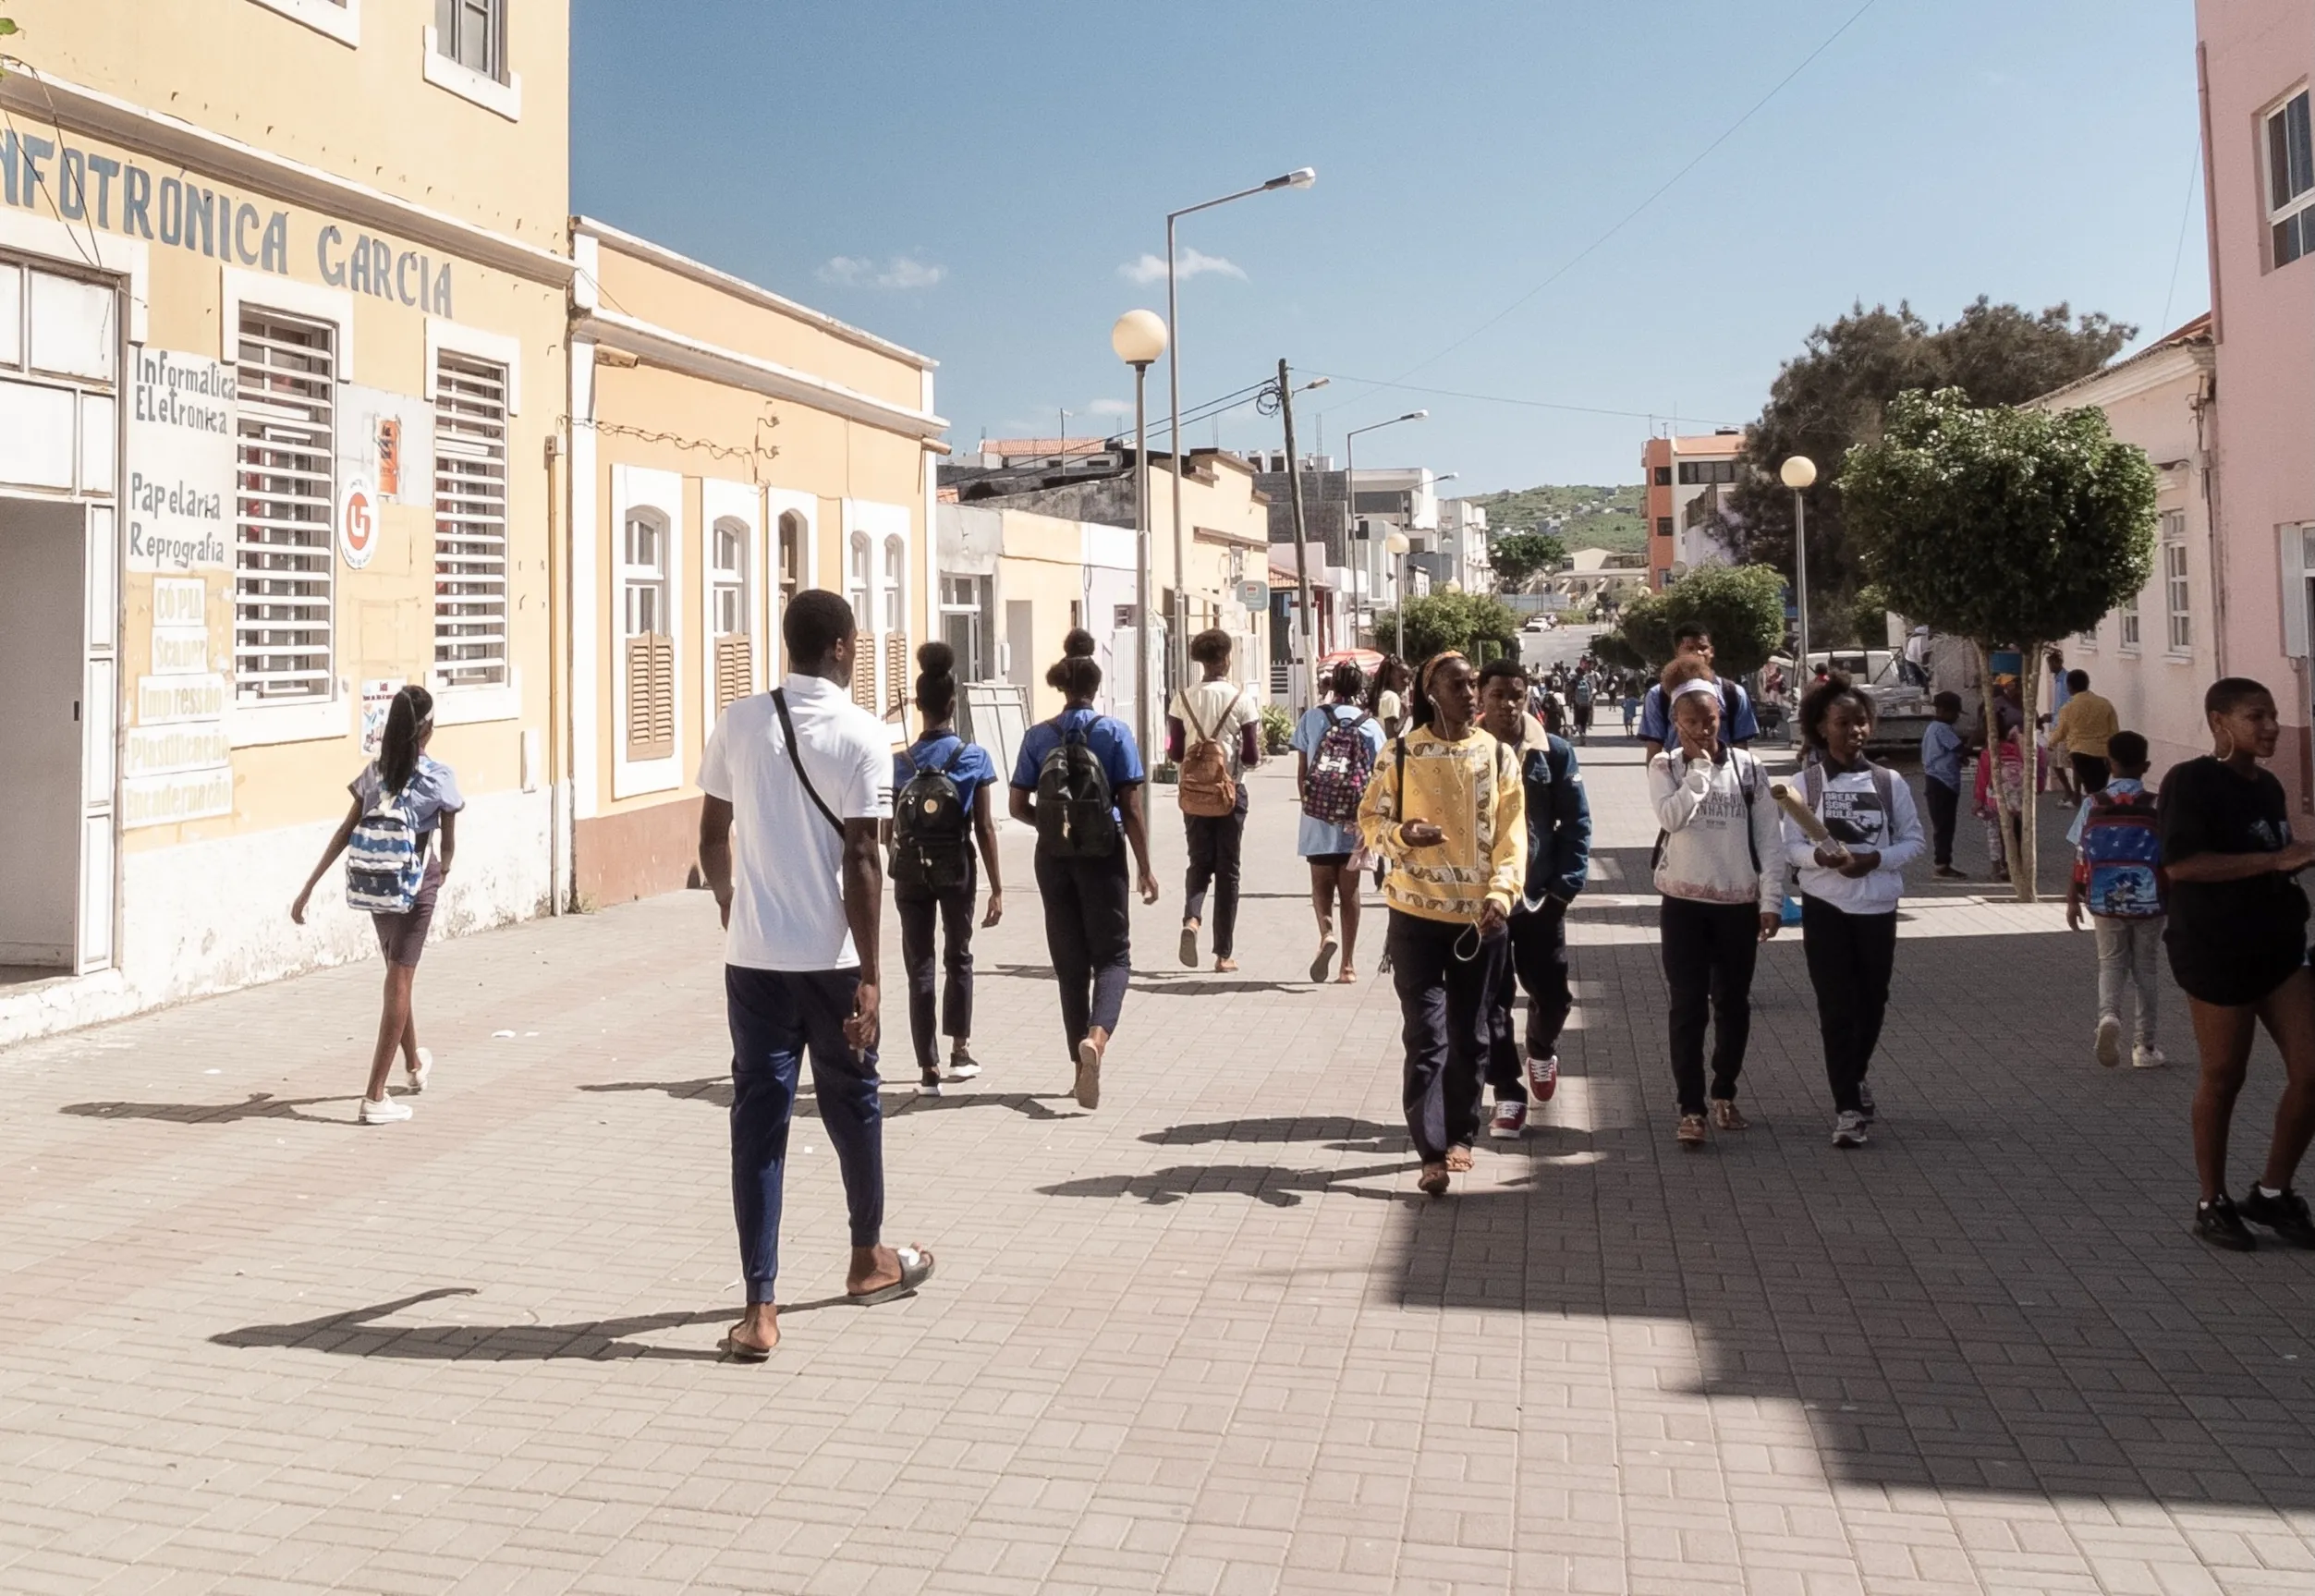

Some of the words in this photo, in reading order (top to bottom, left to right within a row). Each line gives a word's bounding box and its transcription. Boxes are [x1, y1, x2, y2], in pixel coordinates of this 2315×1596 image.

[318, 225, 452, 319] GARCIA
[131, 471, 221, 520] Papelaria
[129, 521, 225, 569] Reprografia
[1712, 791, 1743, 804] AVENU
